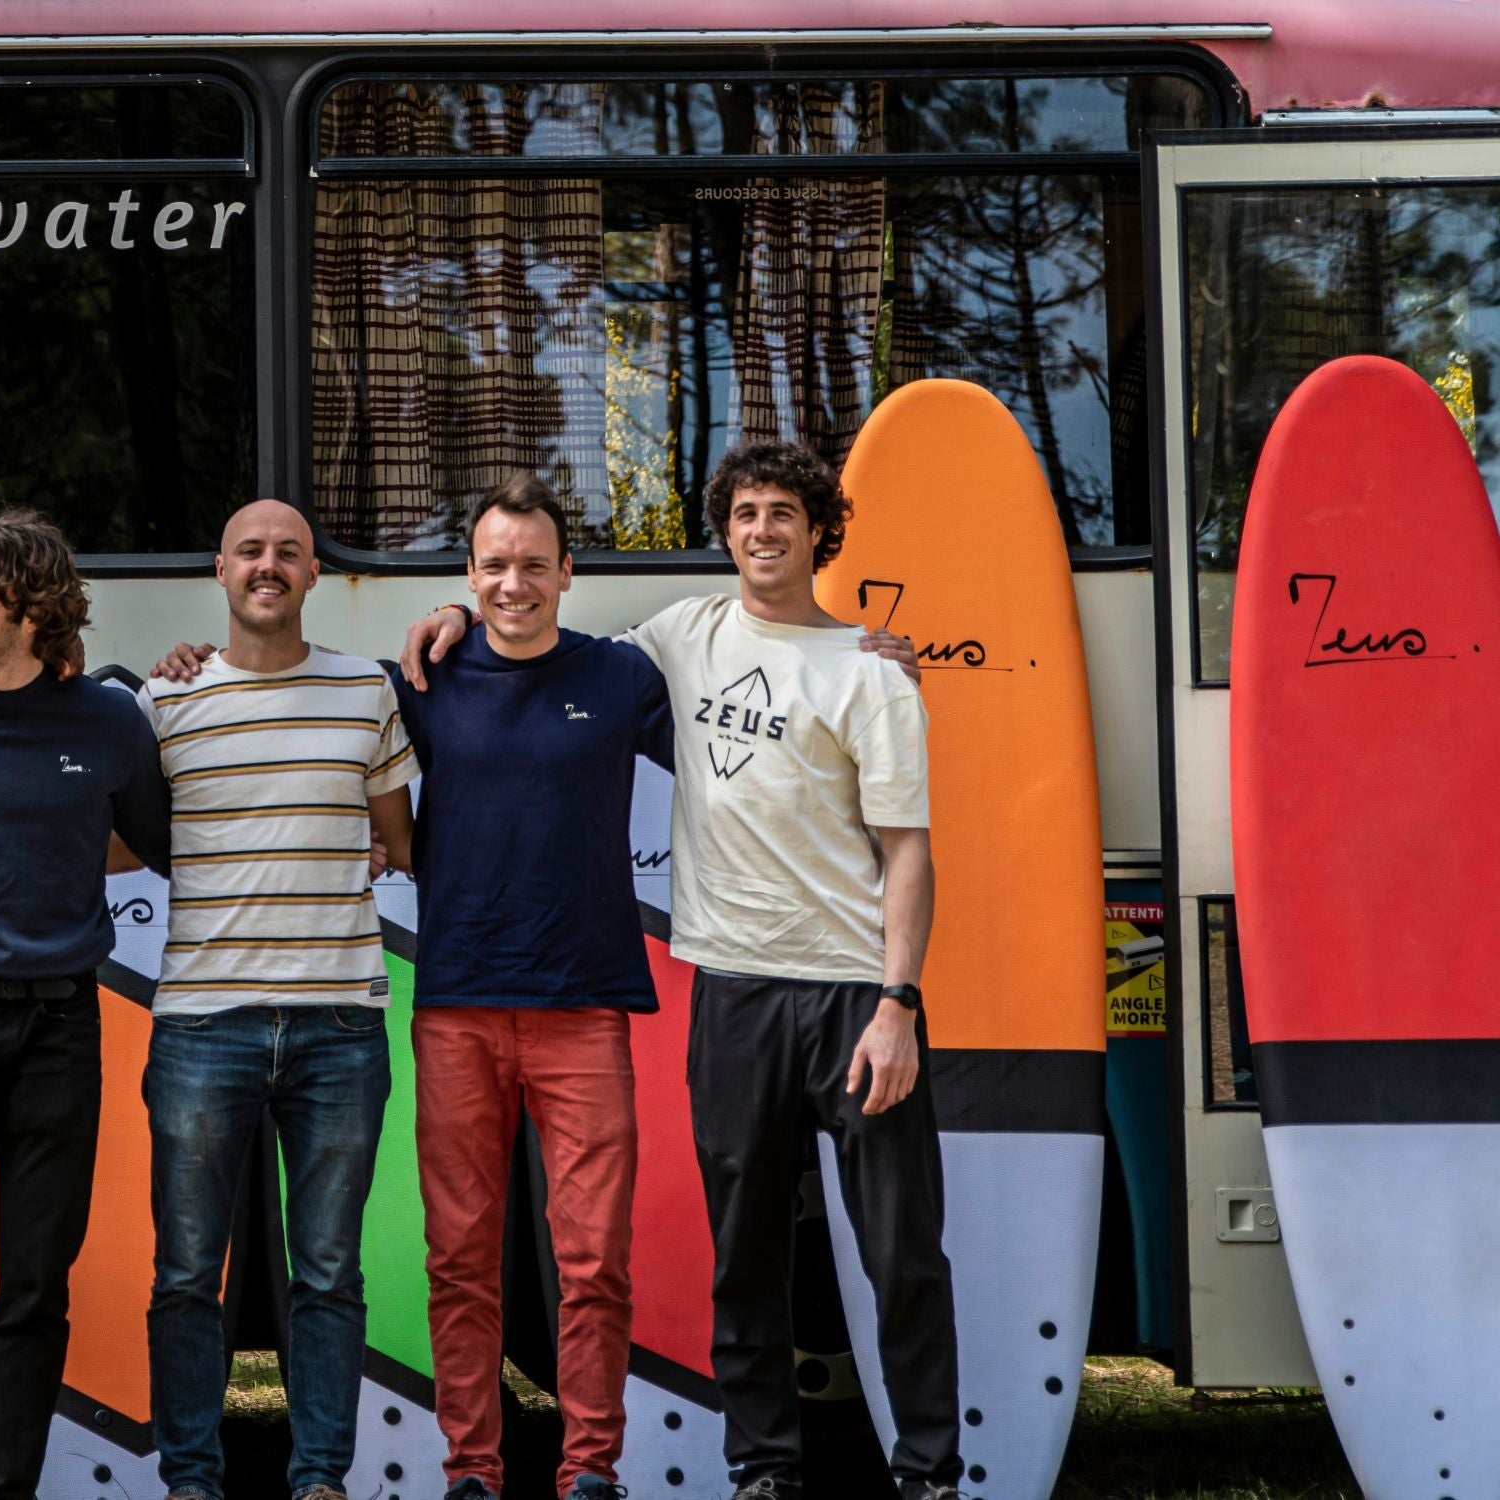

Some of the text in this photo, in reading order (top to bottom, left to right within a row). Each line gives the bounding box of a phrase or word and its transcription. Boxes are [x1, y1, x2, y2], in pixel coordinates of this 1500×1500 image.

[695, 697, 787, 741] ZEUS
[1105, 907, 1164, 919] ATTENTI
[1110, 998, 1164, 1010] ANGLE
